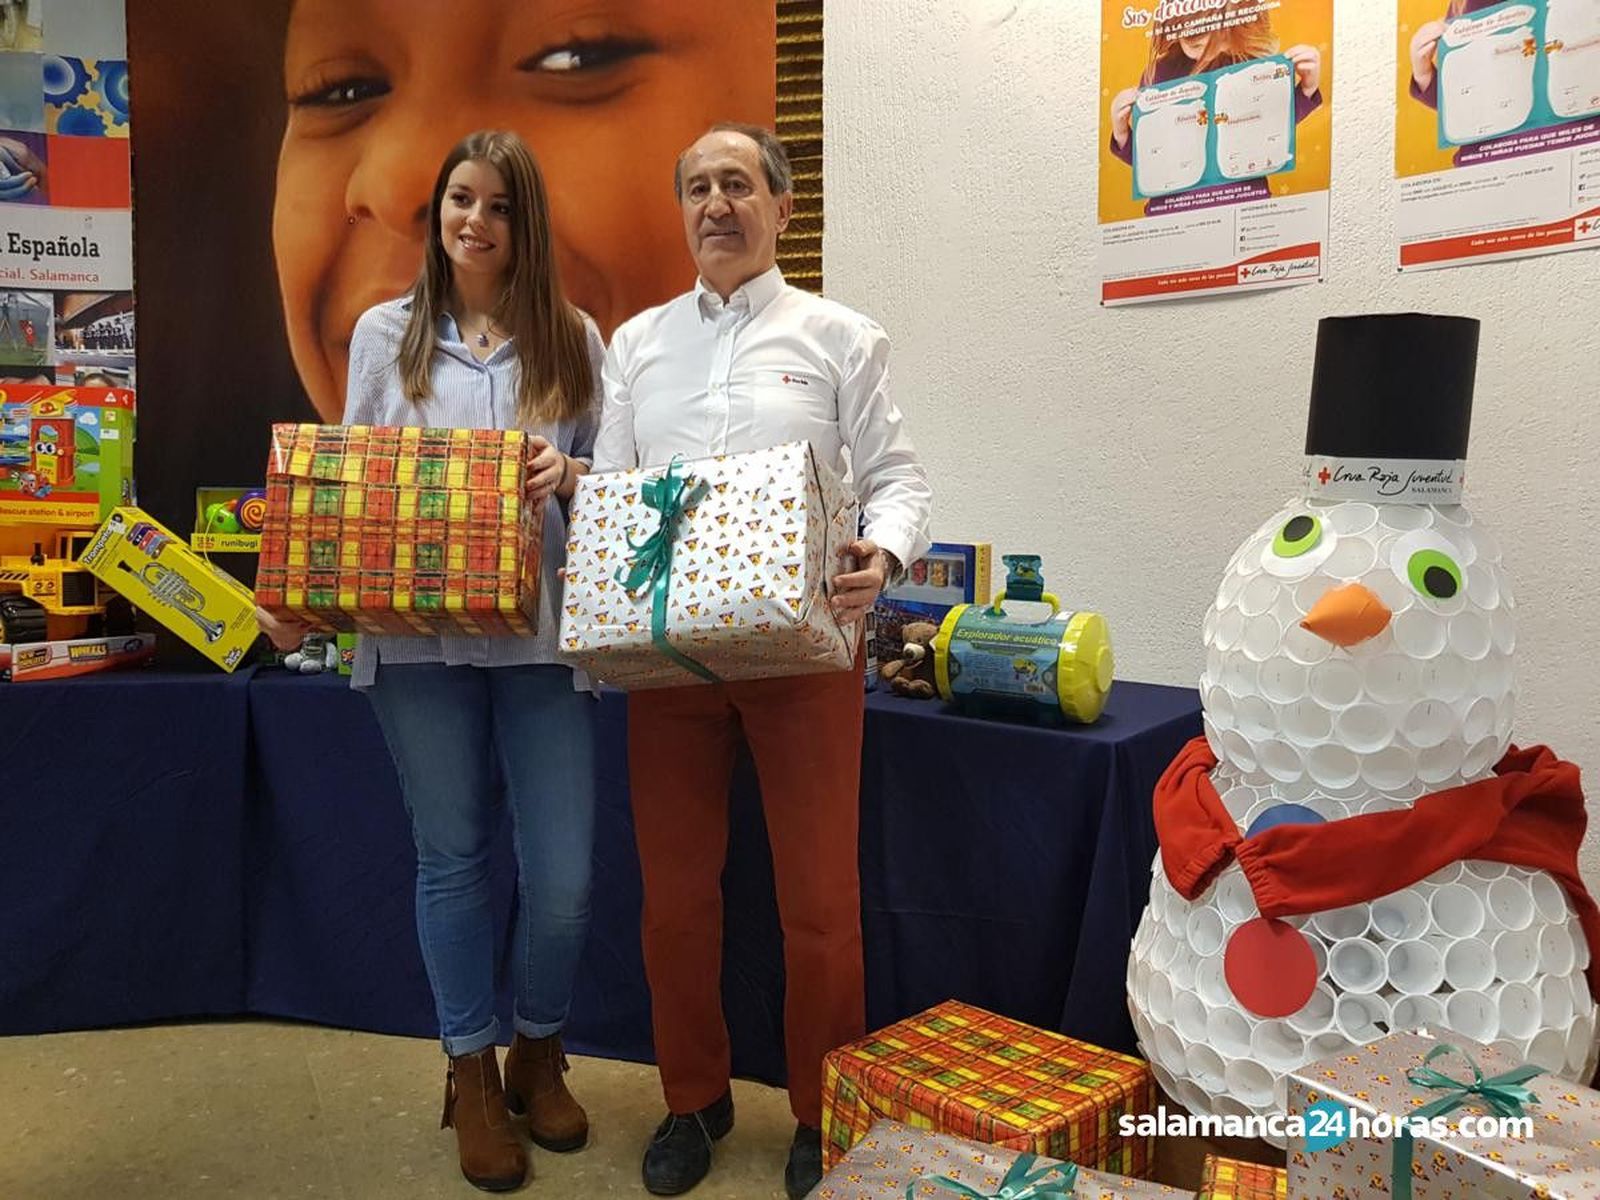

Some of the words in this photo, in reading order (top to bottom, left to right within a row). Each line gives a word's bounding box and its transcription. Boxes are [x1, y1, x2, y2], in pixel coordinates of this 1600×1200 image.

[1122, 7, 1149, 28] Sus
[1164, 25, 1171, 33] A
[1172, 23, 1183, 31] LA
[1184, 14, 1223, 28] CAMPAÑA
[1225, 11, 1236, 19] DE
[1166, 33, 1178, 41] DE
[1178, 23, 1221, 38] JUGUETES
[1223, 14, 1257, 27] NUEVOS
[1480, 139, 1517, 151] COLABORA
[1518, 135, 1539, 144] PARA
[1540, 131, 1557, 140] QUE
[1558, 126, 1581, 137] MILES
[1583, 123, 1595, 132] DE
[1514, 141, 1546, 152] PUEDAN
[1547, 135, 1572, 146] TENER
[7, 232, 101, 262] Española
[29, 268, 100, 284] Salamanca
[1333, 465, 1367, 482] Cruz
[1367, 466, 1400, 491] Roja
[1376, 470, 1454, 496] Juventud
[28, 507, 57, 516] station
[58, 508, 65, 517] &
[66, 510, 95, 519] airport
[956, 628, 1011, 642] Explorador
[1013, 635, 1058, 646] acuático
[70, 643, 108, 658] WHEELS
